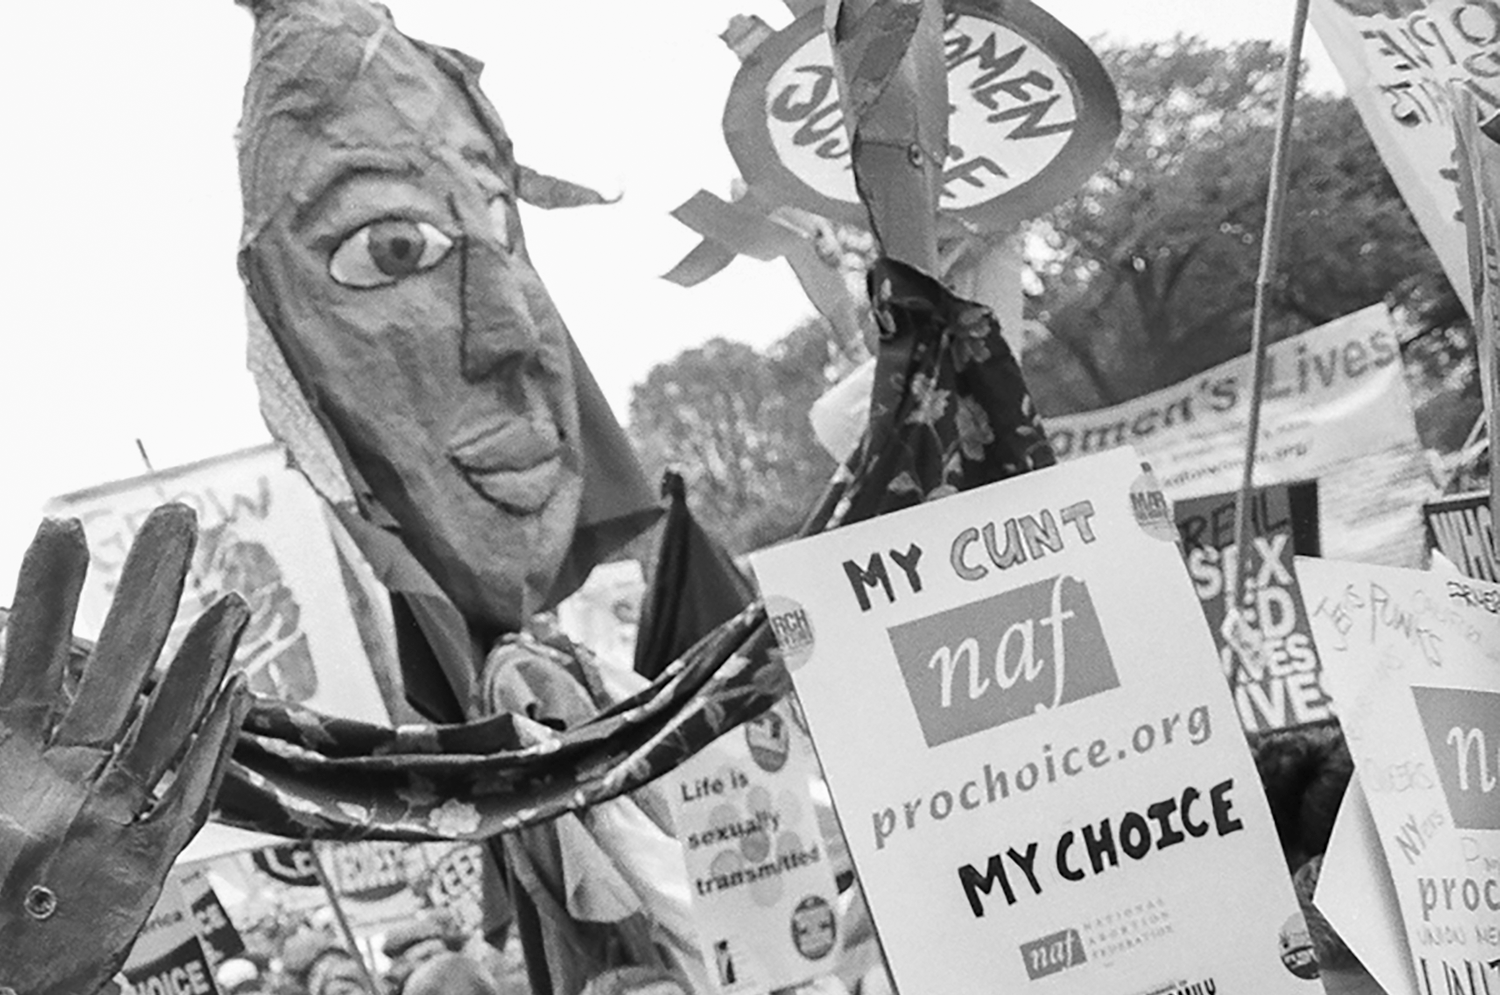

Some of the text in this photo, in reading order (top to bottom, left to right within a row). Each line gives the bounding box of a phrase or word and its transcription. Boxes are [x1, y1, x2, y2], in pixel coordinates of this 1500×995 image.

[842, 500, 1096, 612] MY CUNT
[928, 574, 1085, 714] naf
[680, 769, 750, 802] Life is
[687, 809, 781, 850] sexually
[871, 705, 1212, 850] prochoice.org
[695, 846, 822, 897] transmitted
[957, 779, 1243, 917] MY CHOICE
